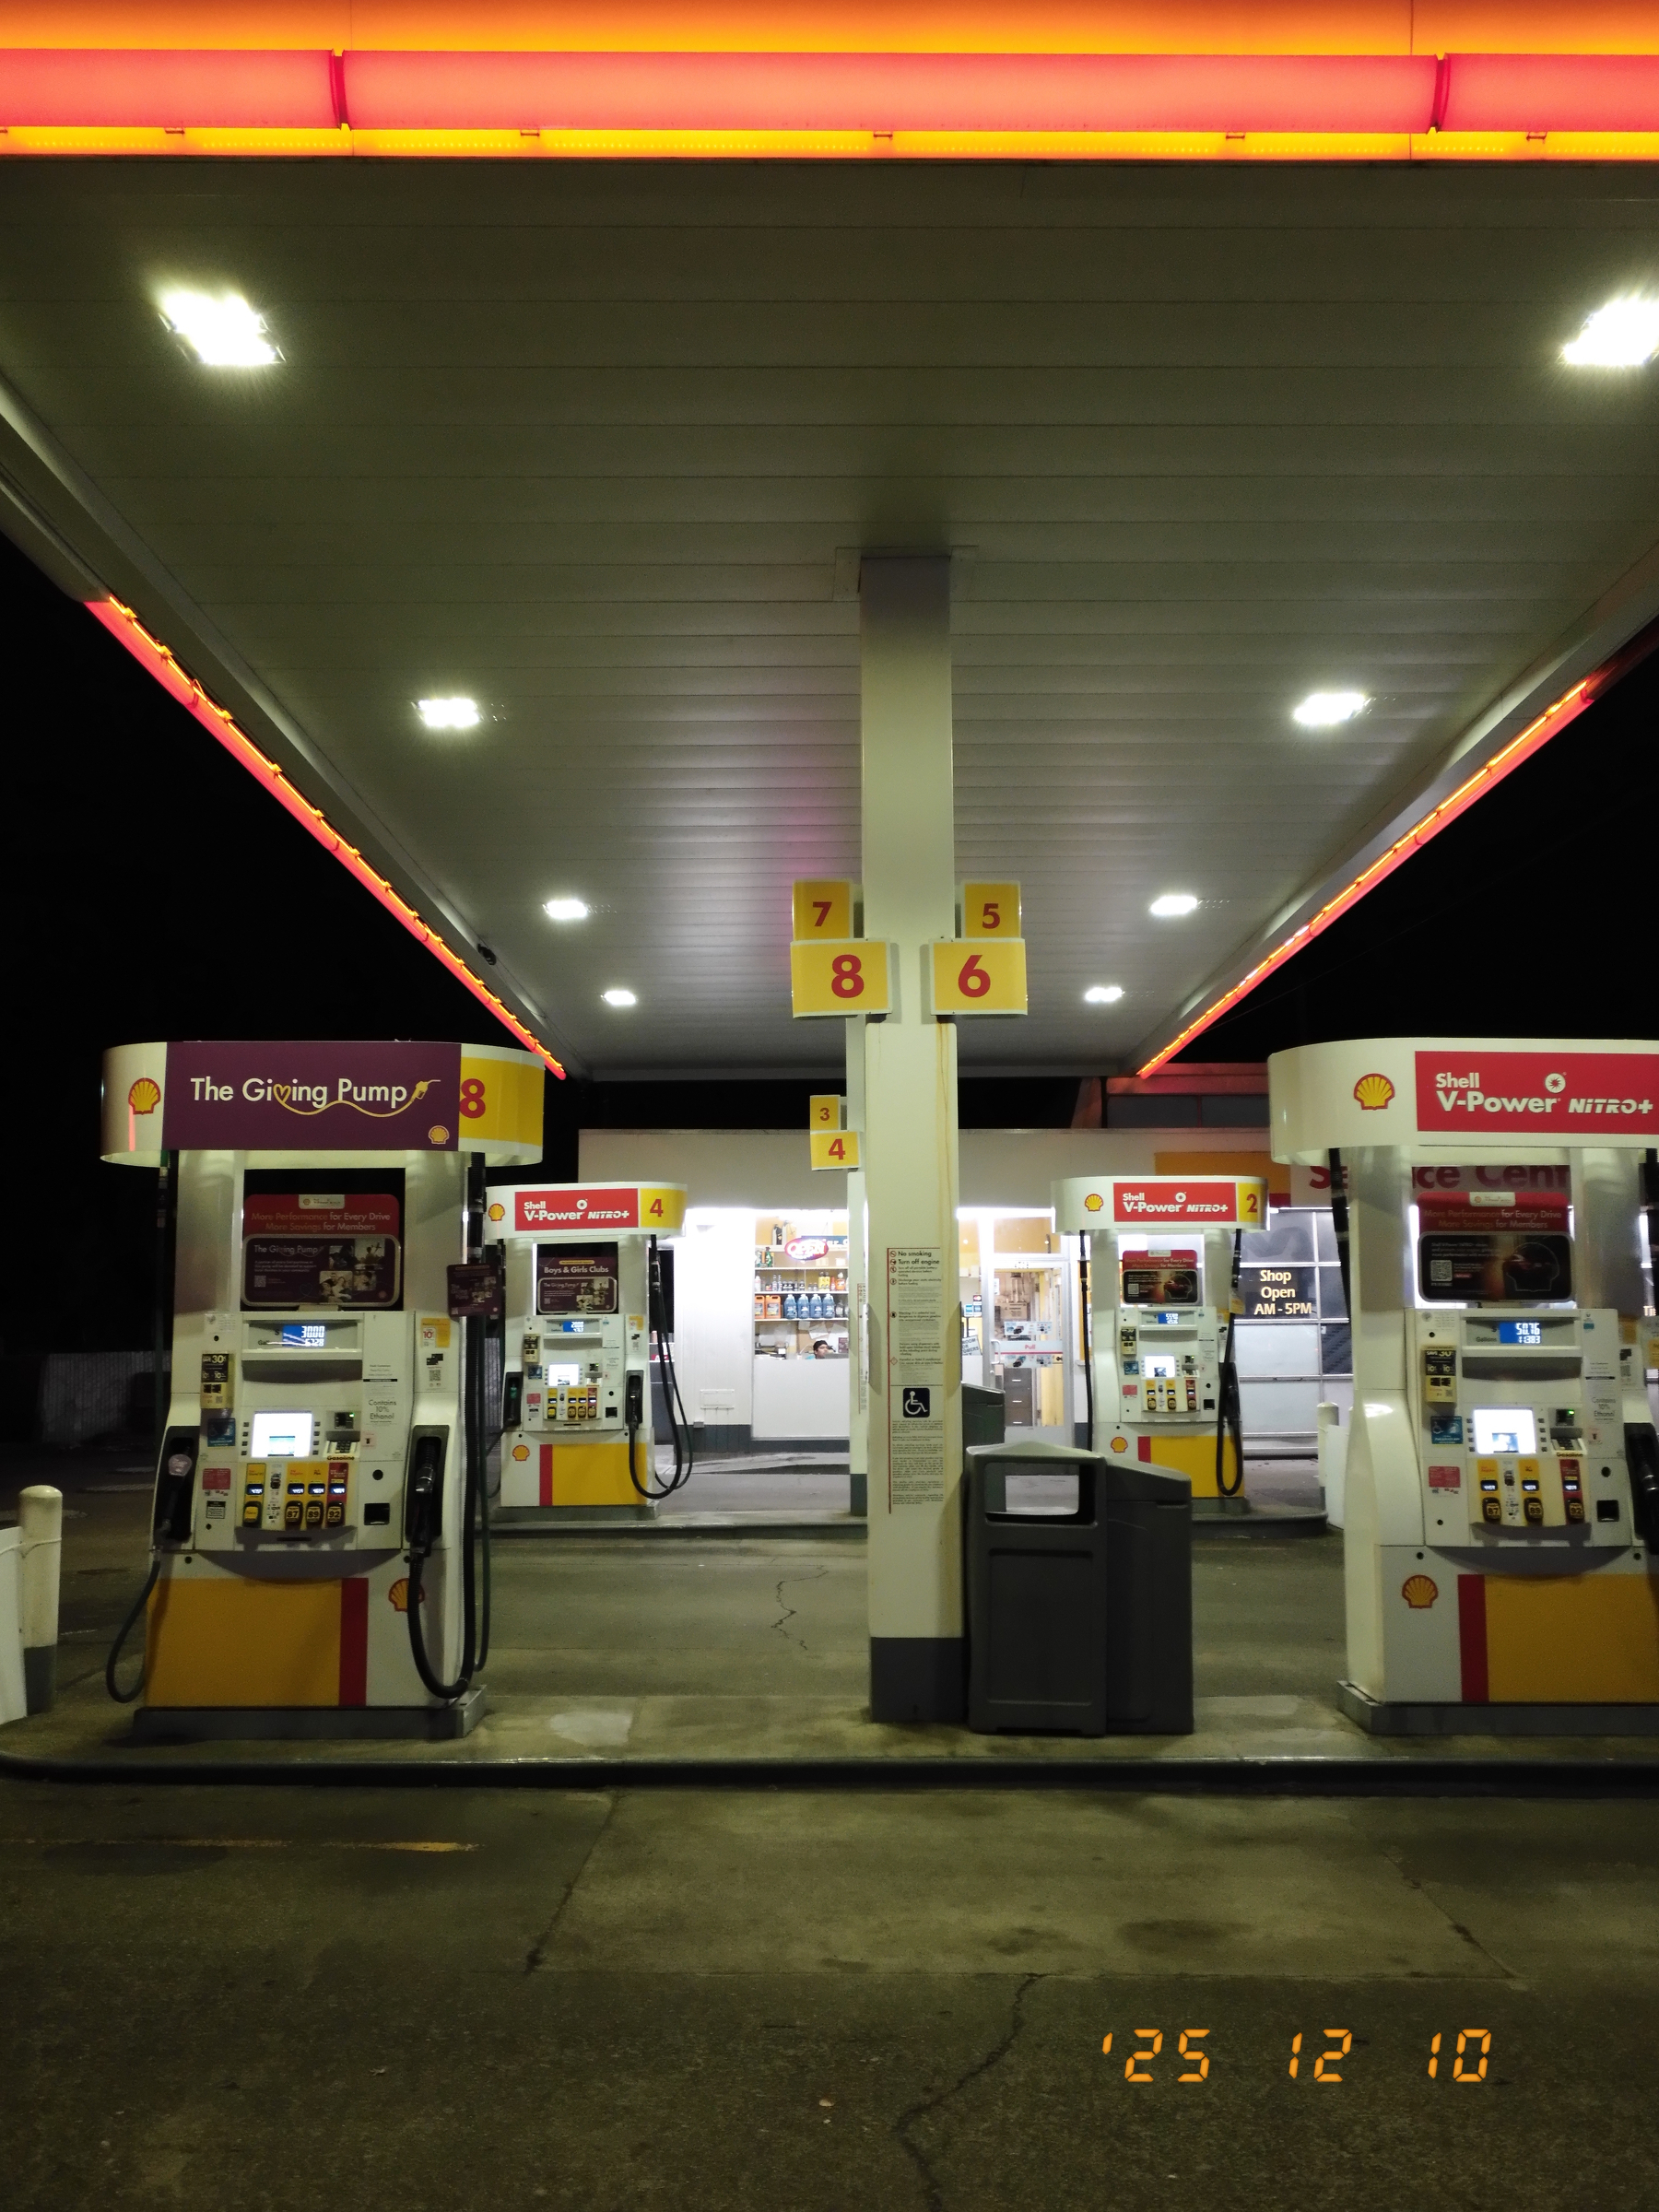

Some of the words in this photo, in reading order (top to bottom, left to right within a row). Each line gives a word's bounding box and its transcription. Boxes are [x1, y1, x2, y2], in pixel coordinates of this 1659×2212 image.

[812, 901, 832, 927] 7
[982, 903, 1001, 929] 5
[831, 954, 865, 998] 8
[958, 955, 991, 997] 6
[1436, 1072, 1480, 1088] Shell
[190, 1076, 234, 1101] The
[337, 1078, 407, 1109] Pump
[459, 1078, 486, 1119] 8
[1436, 1090, 1558, 1113] V-Power
[819, 1108, 830, 1121] 3
[828, 1138, 845, 1160] 4
[1123, 1193, 1145, 1202] Shell
[1246, 1193, 1258, 1213] 2
[524, 1200, 547, 1210] Shell
[649, 1198, 664, 1218] 4
[1123, 1202, 1182, 1213] V-Power
[252, 1213, 274, 1221] More
[276, 1212, 328, 1221] Performance
[329, 1212, 343, 1221] for
[344, 1212, 367, 1222] Every
[370, 1212, 391, 1220] Drive
[524, 1210, 583, 1221] V-Power
[1501, 1209, 1514, 1218] for
[1515, 1210, 1538, 1219] Every
[1540, 1210, 1562, 1218] Drive
[289, 1222, 322, 1232] Savings
[323, 1222, 336, 1230] for
[336, 1222, 376, 1230] Members
[1496, 1219, 1509, 1228] for
[1510, 1219, 1548, 1228] Members
[297, 1245, 319, 1254] Pump
[787, 1240, 828, 1258] OPEN
[544, 1266, 562, 1275] Boys
[1260, 1270, 1292, 1284] Shop
[1261, 1287, 1296, 1301] Open
[1253, 1303, 1277, 1315] AM
[1285, 1302, 1312, 1315] 5PM
[301, 1325, 325, 1338] 30.00
[1515, 1323, 1540, 1335] 50.76
